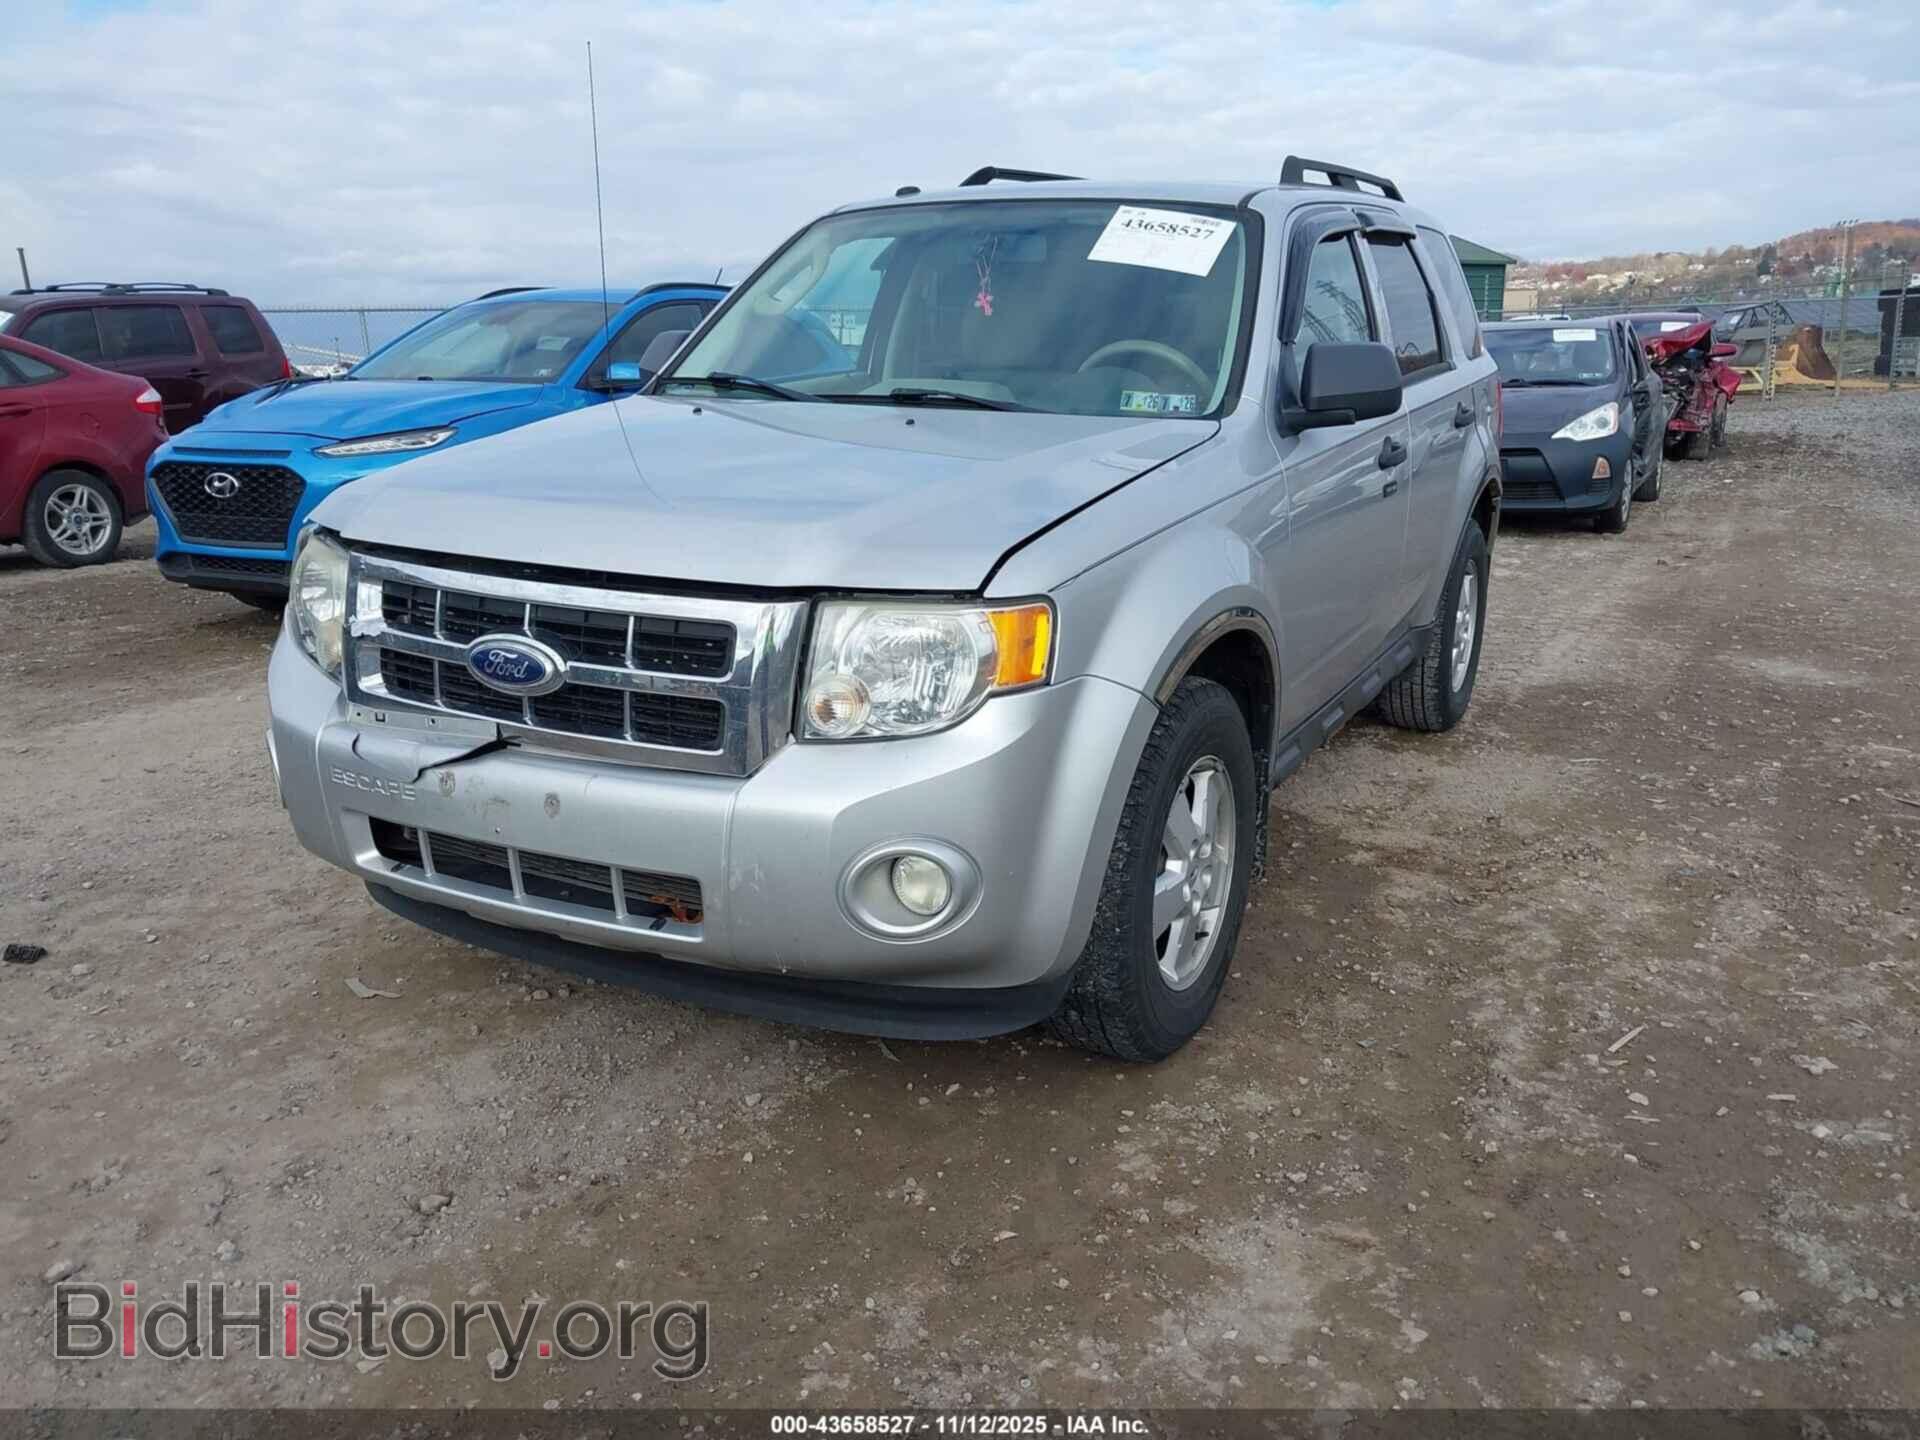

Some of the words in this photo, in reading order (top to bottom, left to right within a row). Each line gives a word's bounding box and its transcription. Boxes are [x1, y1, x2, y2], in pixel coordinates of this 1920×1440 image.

[1121, 218, 1215, 240] 43658527
[485, 649, 529, 680] Ford
[331, 766, 417, 801] ESCAPE
